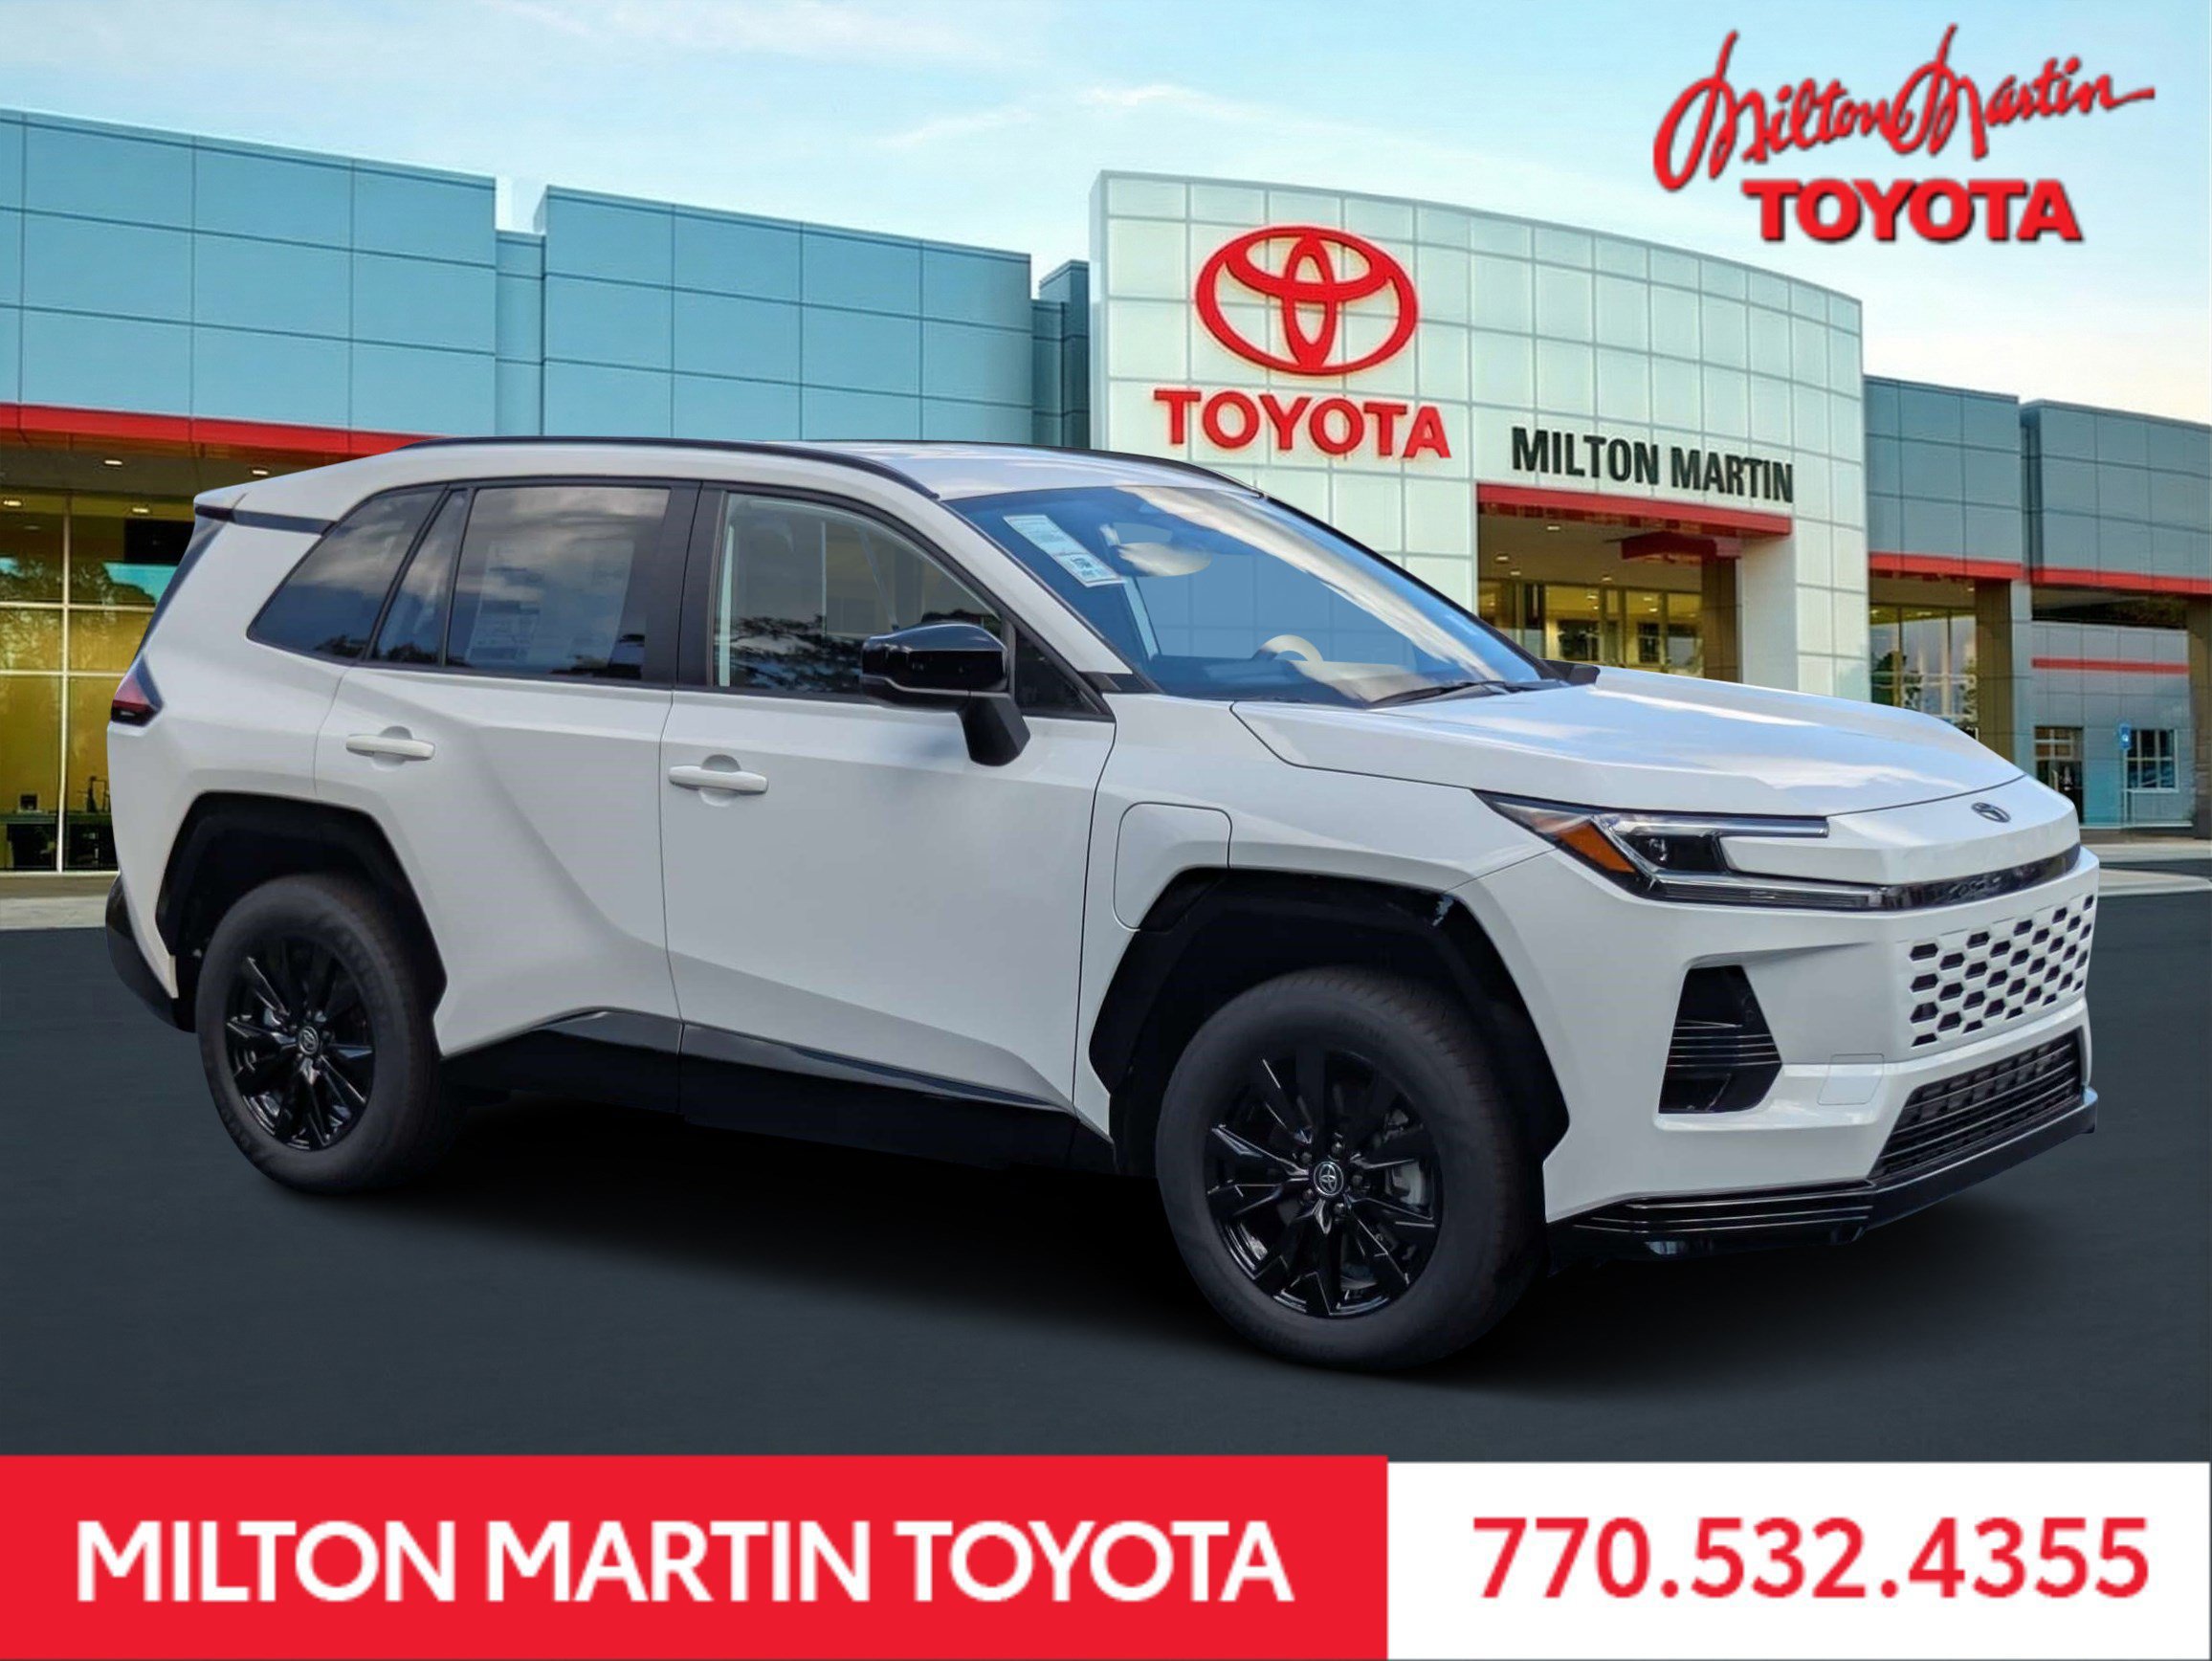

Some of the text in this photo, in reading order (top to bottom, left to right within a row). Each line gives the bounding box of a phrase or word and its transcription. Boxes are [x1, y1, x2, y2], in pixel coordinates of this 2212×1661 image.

[1155, 388, 1451, 459] TOYOTA
[1512, 426, 1795, 504] MILTON MARTIN
